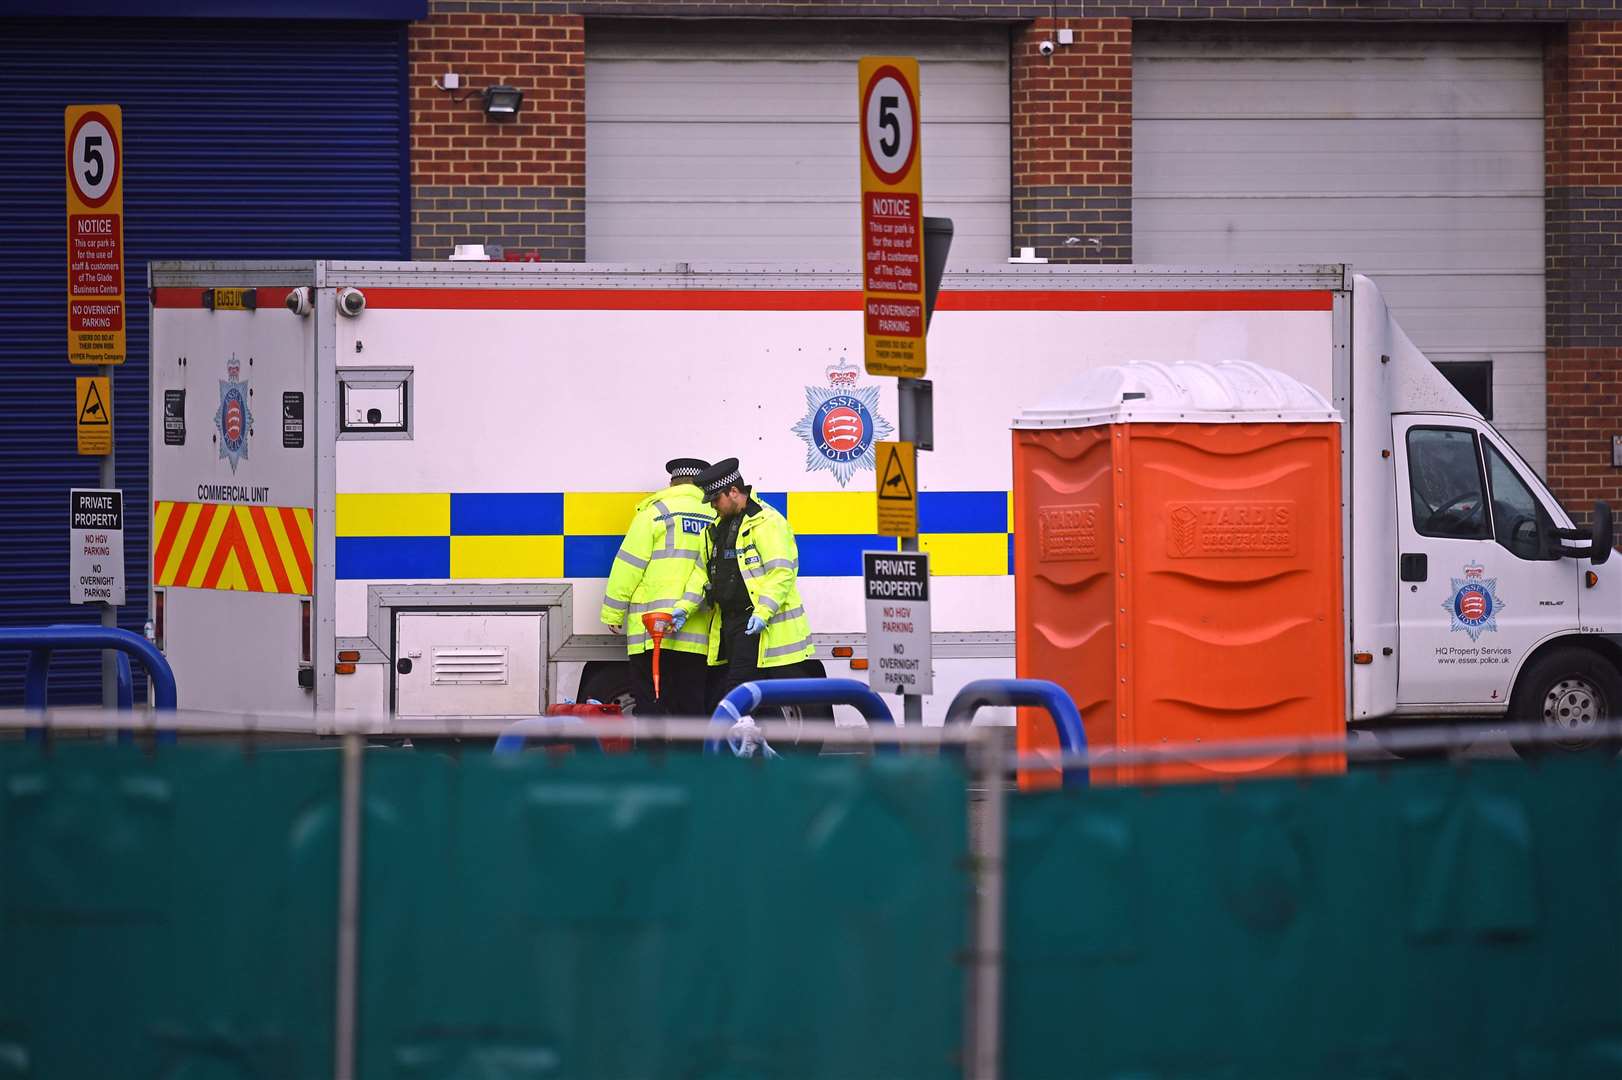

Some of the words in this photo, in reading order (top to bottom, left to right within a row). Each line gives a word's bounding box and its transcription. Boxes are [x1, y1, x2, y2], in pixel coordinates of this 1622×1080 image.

[879, 96, 900, 157] 5
[84, 136, 104, 186] 5
[873, 198, 911, 216] NOTICE
[78, 220, 112, 232] NOTICE
[870, 222, 882, 232] This
[894, 224, 908, 234] park
[909, 225, 915, 234] is
[74, 239, 86, 247] This
[97, 240, 109, 249] park
[872, 236, 882, 246] for
[882, 238, 893, 247] the
[906, 239, 912, 248] of
[86, 250, 95, 258] the
[107, 250, 112, 258] of
[867, 250, 881, 260] staff
[887, 253, 919, 262] customers
[72, 262, 84, 270] staff
[85, 262, 89, 270] &
[90, 262, 119, 270] customers
[874, 266, 881, 275] of
[882, 265, 894, 276] The
[895, 266, 912, 276] Glade
[79, 274, 84, 282] of
[85, 273, 95, 282] The
[96, 273, 112, 282] Glade
[74, 285, 99, 294] Business
[100, 285, 118, 294] Centre
[869, 278, 897, 290] Business
[898, 280, 918, 291] Centre
[72, 305, 82, 314] NO
[83, 305, 120, 315] OVERNIGHT
[868, 304, 879, 315] NO
[880, 304, 920, 317] OVERNIGHT
[82, 318, 111, 327] PARKING
[879, 320, 911, 332] PARKING
[822, 396, 865, 416] ESSEX
[819, 442, 868, 461] POLICE
[198, 484, 249, 501] COMMERCIAL
[251, 487, 269, 502] UNIT
[80, 496, 113, 509] PRIVATE
[75, 514, 118, 526] PROPERTY
[1200, 506, 1290, 526] TARDIS
[85, 534, 94, 543] NO
[95, 535, 108, 543] HGV
[84, 547, 110, 556] PARKING
[92, 564, 102, 573] NO
[875, 560, 916, 576] PRIVATE
[80, 576, 114, 586] OVERNIGHT
[84, 588, 111, 598] PARKING
[870, 581, 923, 596] PROPERTY
[1460, 585, 1487, 596] ESSEX
[883, 608, 894, 618] NO
[896, 608, 911, 618] HGV
[1458, 612, 1490, 626] POLICE
[883, 622, 914, 633] PARKING
[893, 644, 904, 654] NO
[1449, 648, 1479, 656] Property
[1481, 647, 1512, 655] Services
[880, 658, 920, 670] OVERNIGHT
[885, 673, 916, 685] PARKING
